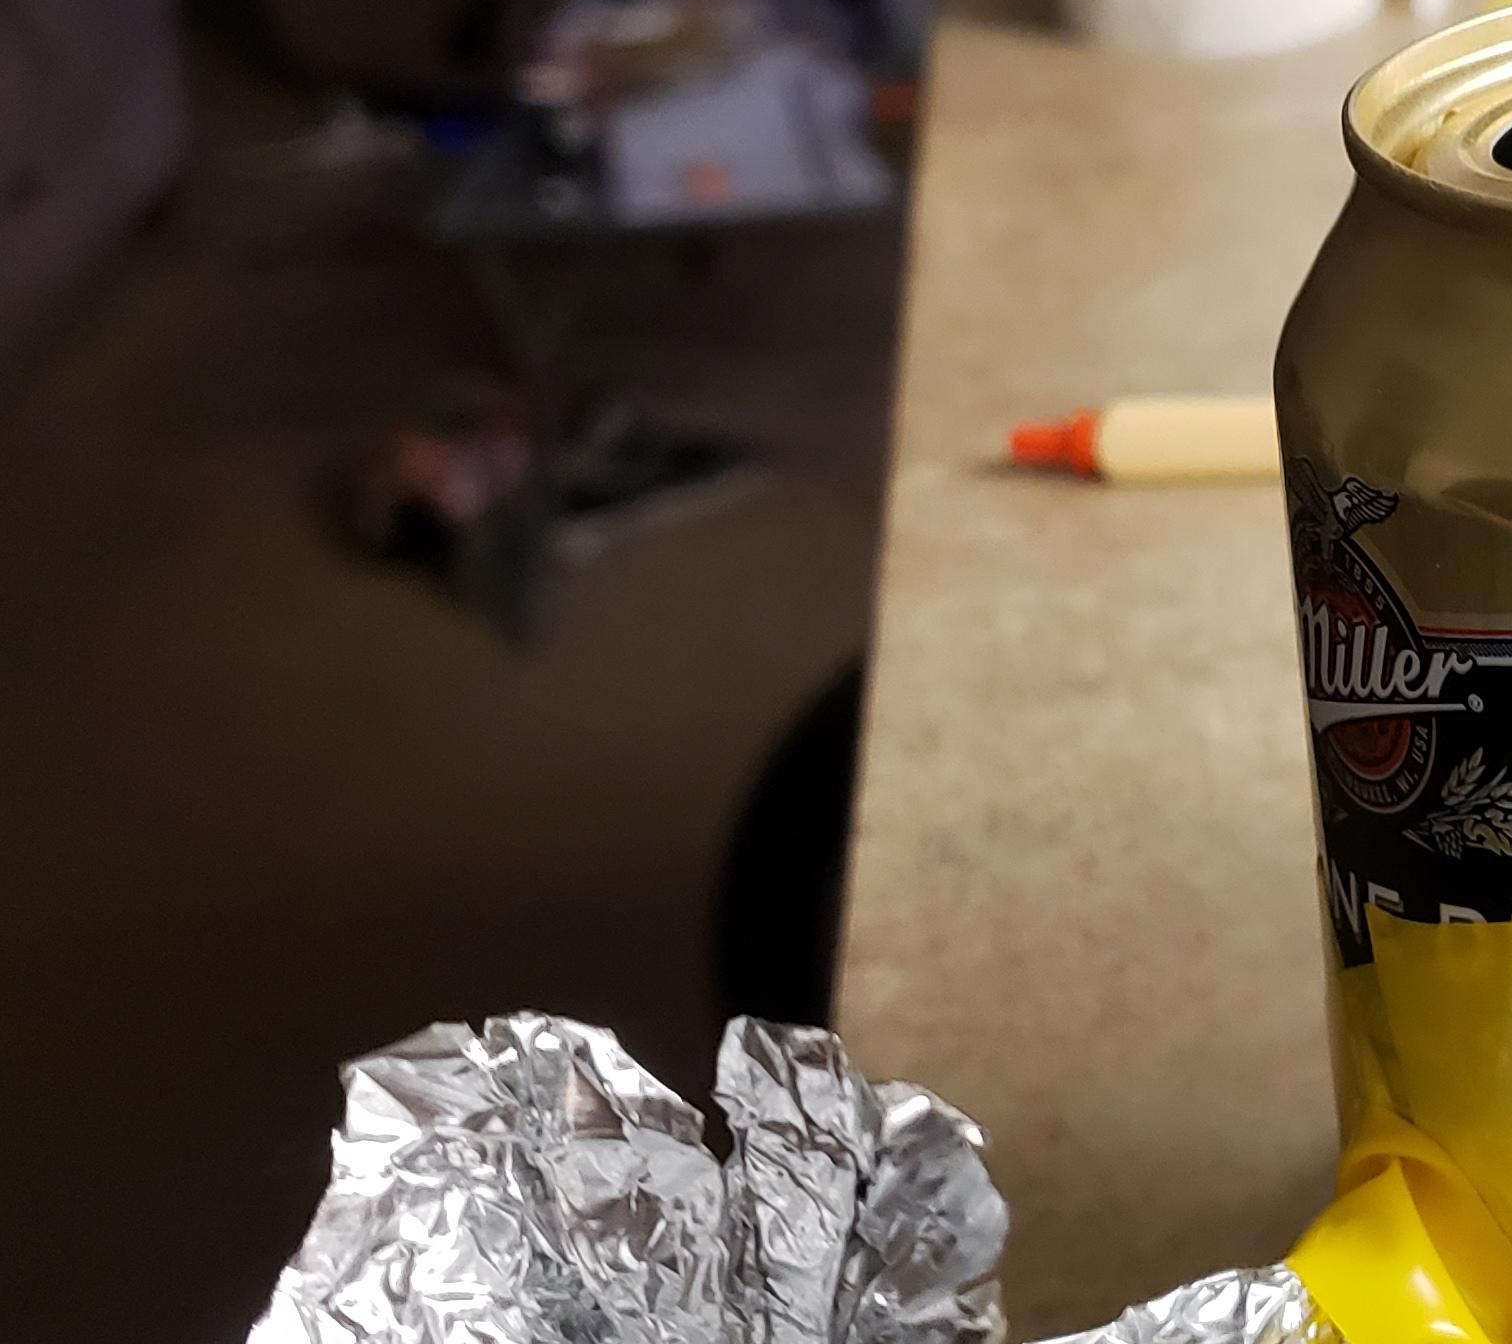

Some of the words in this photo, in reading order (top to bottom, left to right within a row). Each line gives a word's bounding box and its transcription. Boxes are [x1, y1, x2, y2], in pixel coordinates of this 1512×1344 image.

[1344, 552, 1387, 612] 1855
[1300, 594, 1474, 700] Miller
[1411, 723, 1430, 765] USA
